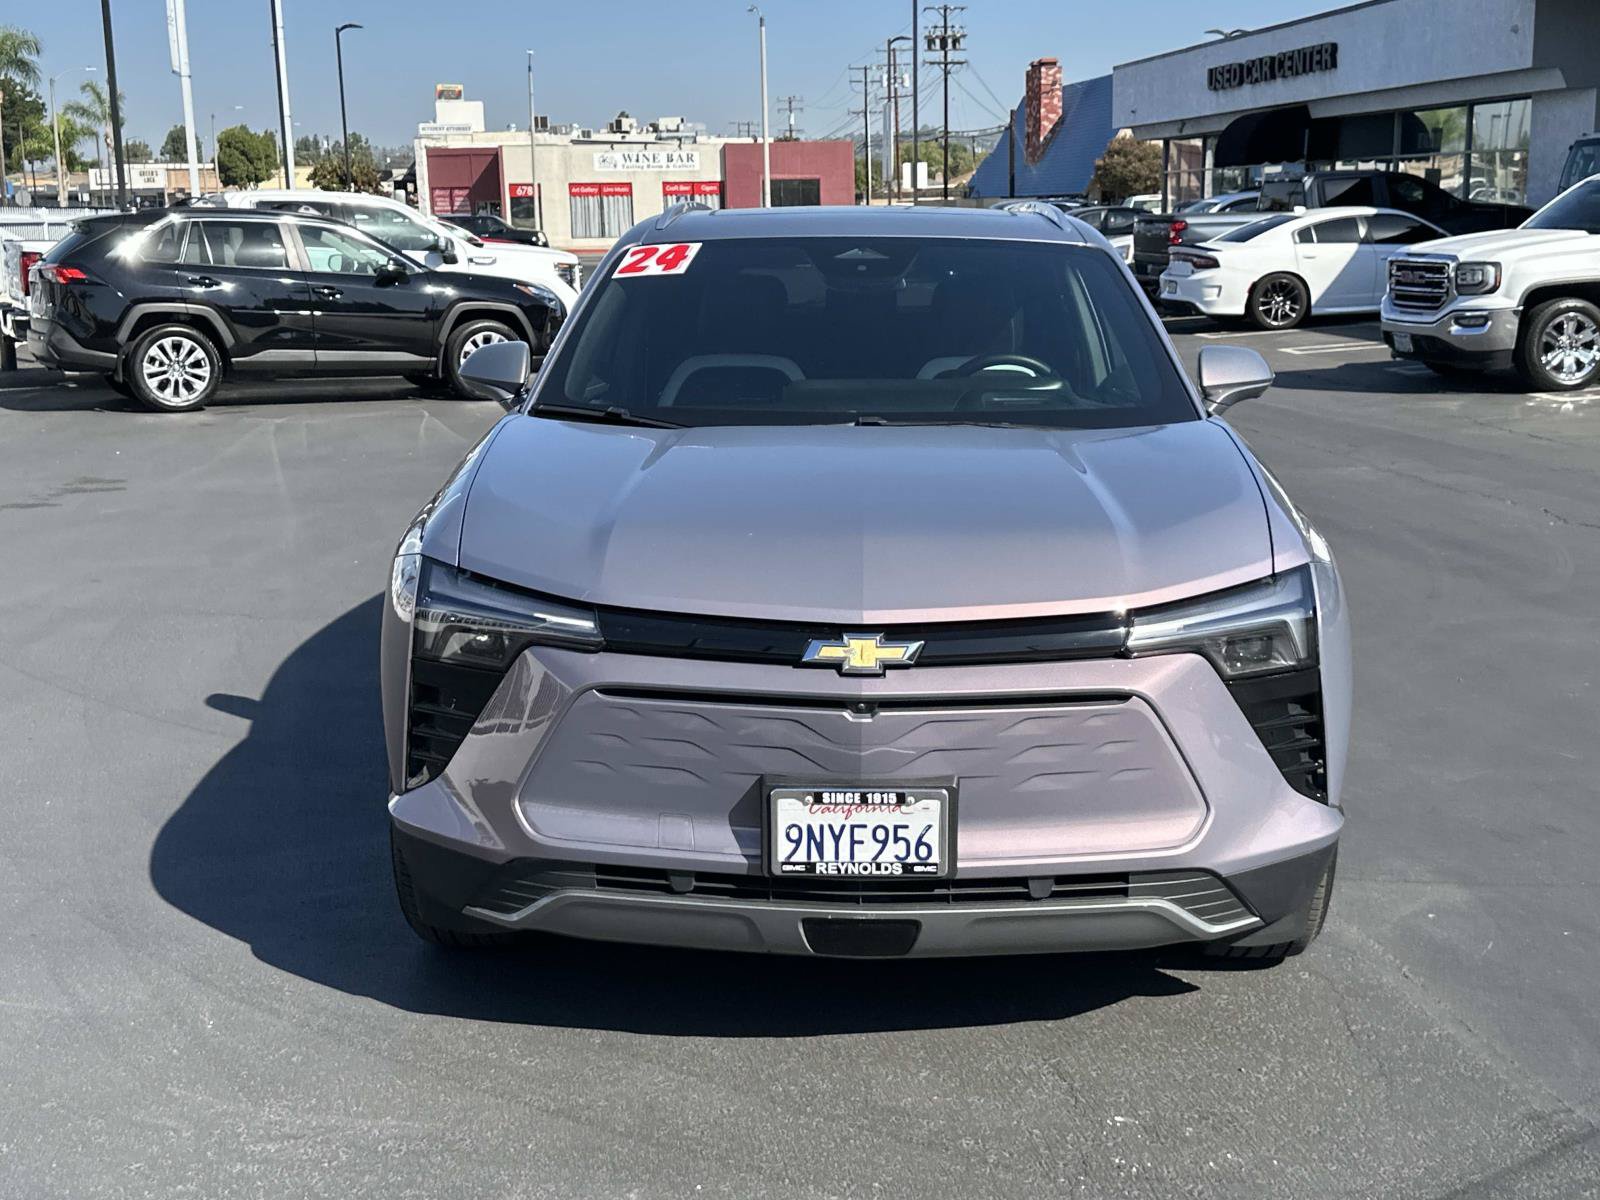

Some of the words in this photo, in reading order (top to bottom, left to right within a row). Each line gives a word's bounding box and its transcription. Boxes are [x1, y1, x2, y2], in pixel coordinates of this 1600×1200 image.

[1208, 63, 1243, 91] USED
[1243, 56, 1274, 84] CAR
[1275, 43, 1338, 78] CENTER
[622, 153, 660, 163] WINE
[666, 153, 694, 163] BAR
[516, 185, 533, 196] 678
[617, 245, 690, 274] 24
[822, 792, 861, 804] SINCE
[866, 792, 897, 804] 1915
[808, 803, 915, 820] California
[785, 823, 933, 862] 9NYF956
[815, 863, 903, 875] REYNOLDS
